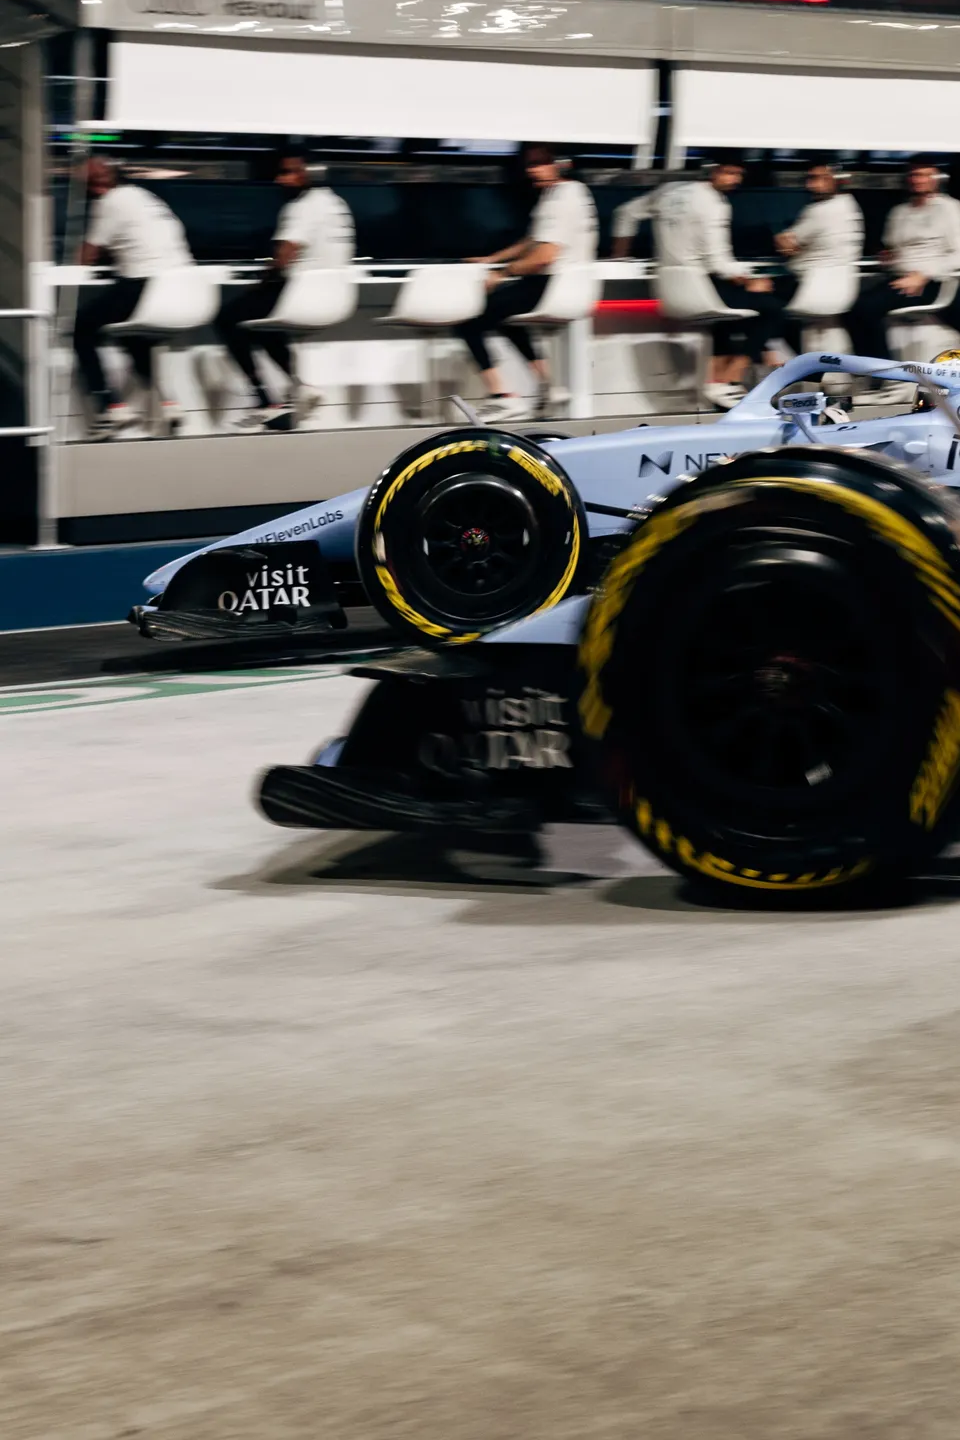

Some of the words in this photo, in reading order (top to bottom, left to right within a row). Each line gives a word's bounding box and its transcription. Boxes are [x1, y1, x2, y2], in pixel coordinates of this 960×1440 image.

[936, 368, 947, 377] OF
[246, 563, 310, 587] visit
[218, 586, 312, 616] QATAR
